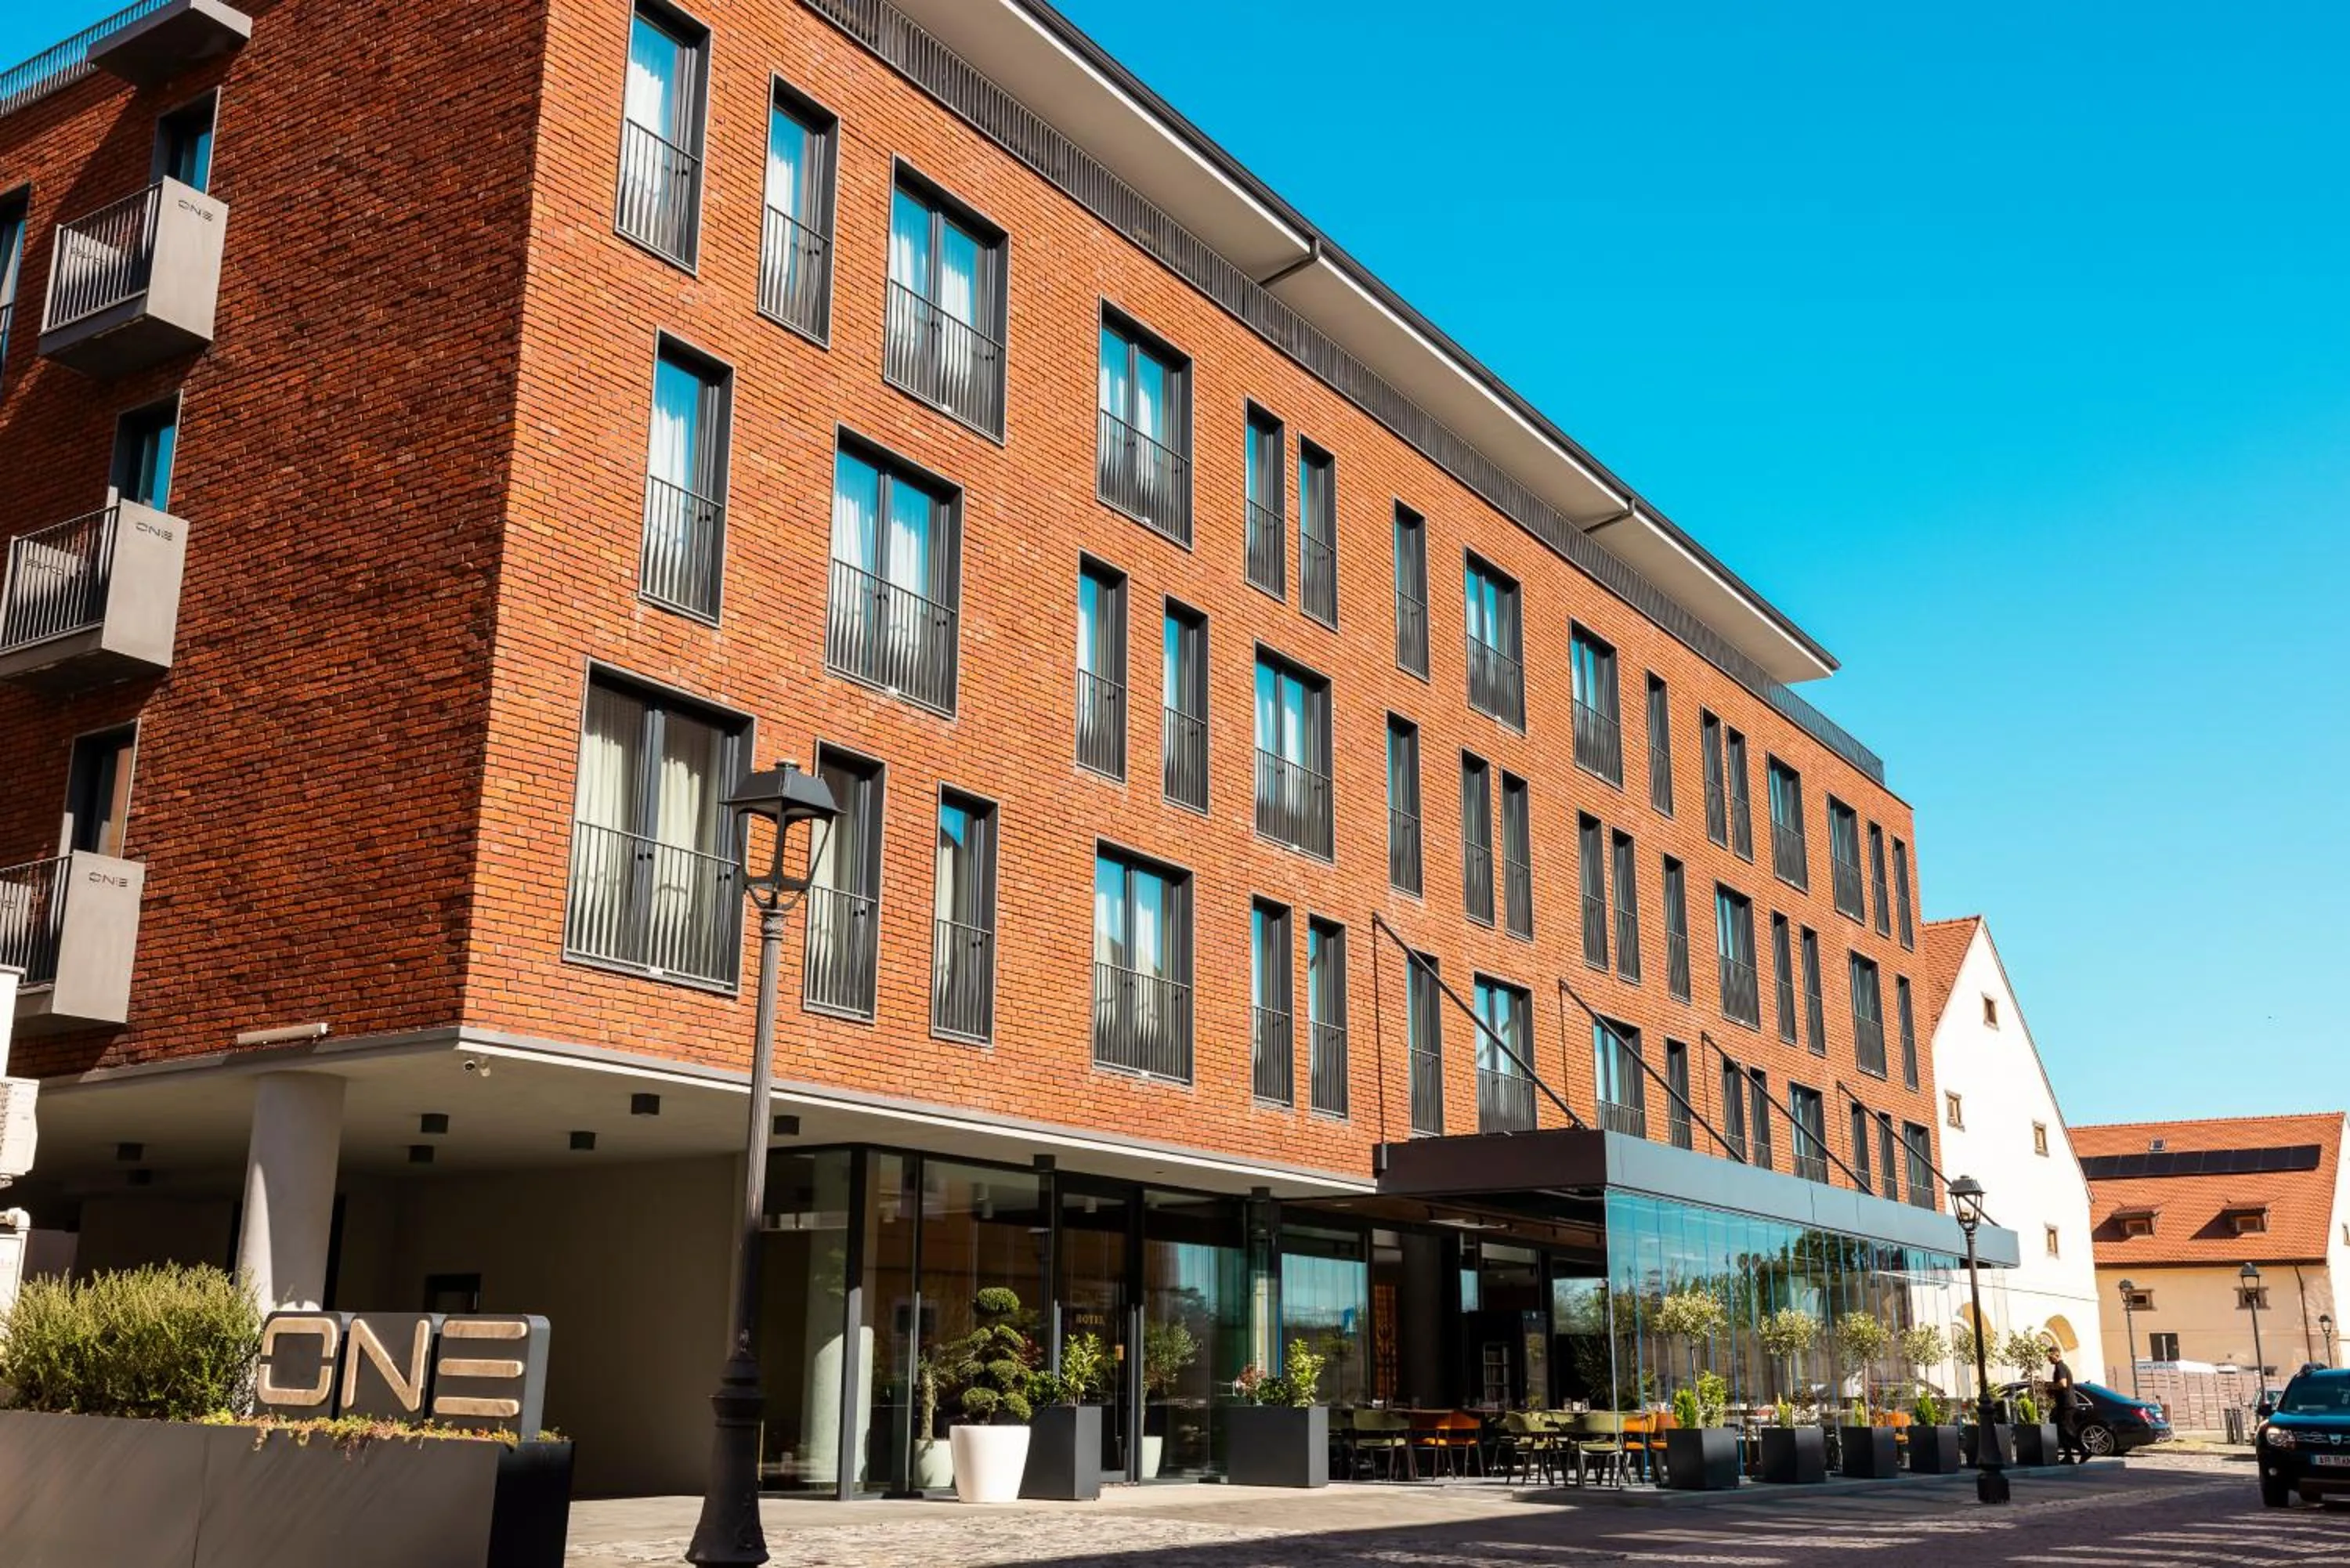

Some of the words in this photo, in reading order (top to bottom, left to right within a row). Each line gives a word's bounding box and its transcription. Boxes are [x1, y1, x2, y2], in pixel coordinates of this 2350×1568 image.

[136, 522, 172, 541] ONE
[89, 872, 128, 887] ONE
[257, 1317, 527, 1417] ONE
